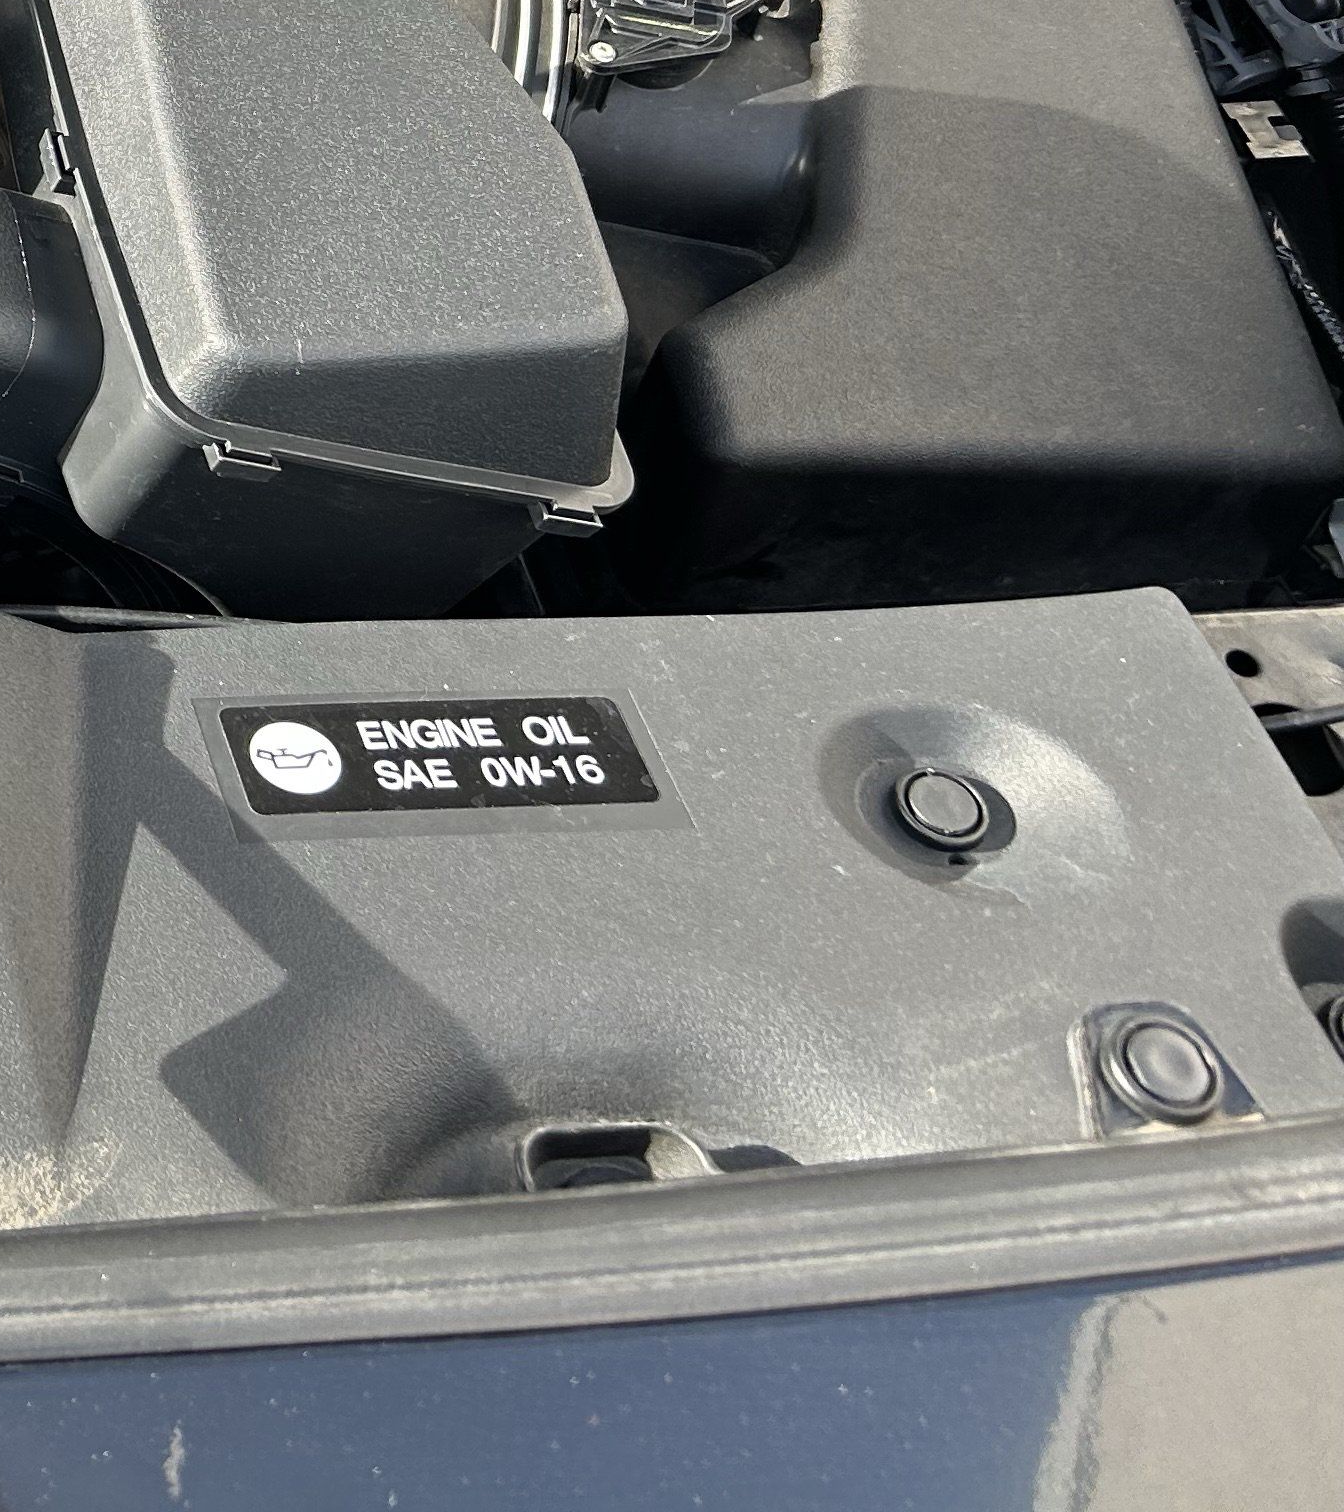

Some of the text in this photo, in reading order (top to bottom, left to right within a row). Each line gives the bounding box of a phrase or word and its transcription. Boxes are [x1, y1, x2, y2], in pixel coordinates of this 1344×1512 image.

[355, 714, 591, 751] ENGINE OIL
[372, 755, 606, 791] SAE 0W-16
